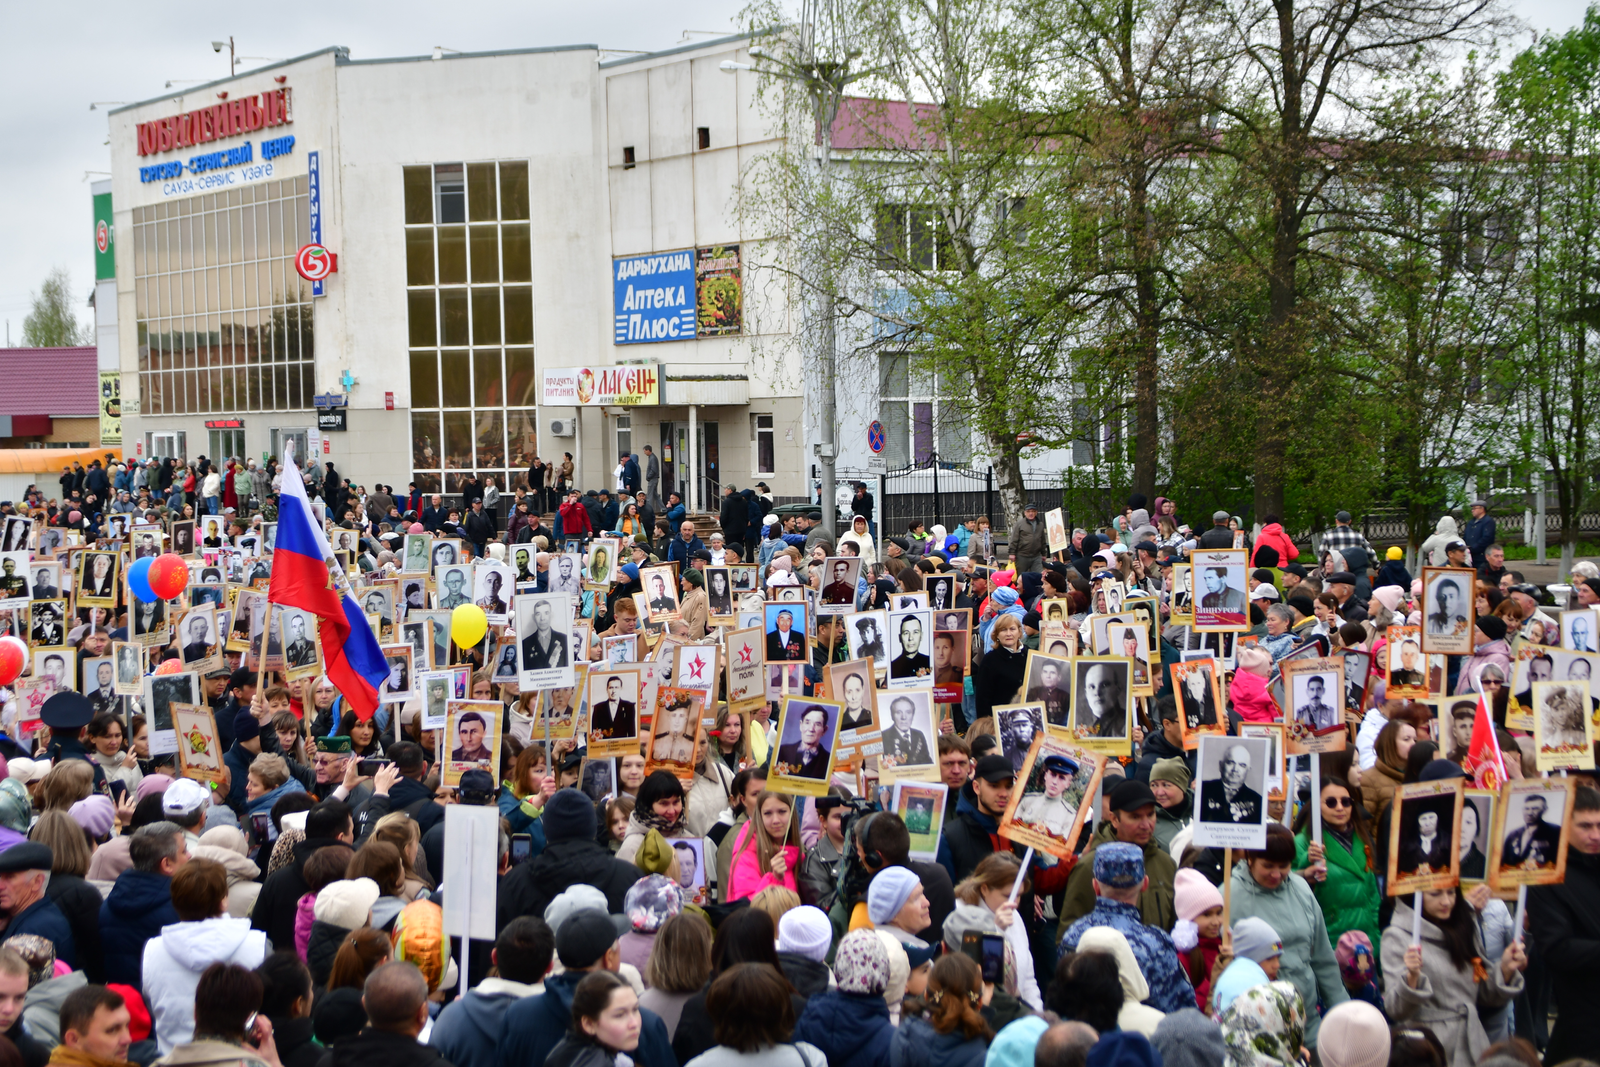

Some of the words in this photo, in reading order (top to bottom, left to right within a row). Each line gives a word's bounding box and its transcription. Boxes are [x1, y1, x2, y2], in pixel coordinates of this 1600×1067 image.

[136, 75, 293, 156] ЮБИЛЕЙНЫЙ
[139, 141, 253, 183] ТОРГОВО-СЕРВИСНЫЙ
[261, 135, 295, 161] ЦЕНТР
[617, 253, 691, 281] ДАРЫУХАНА
